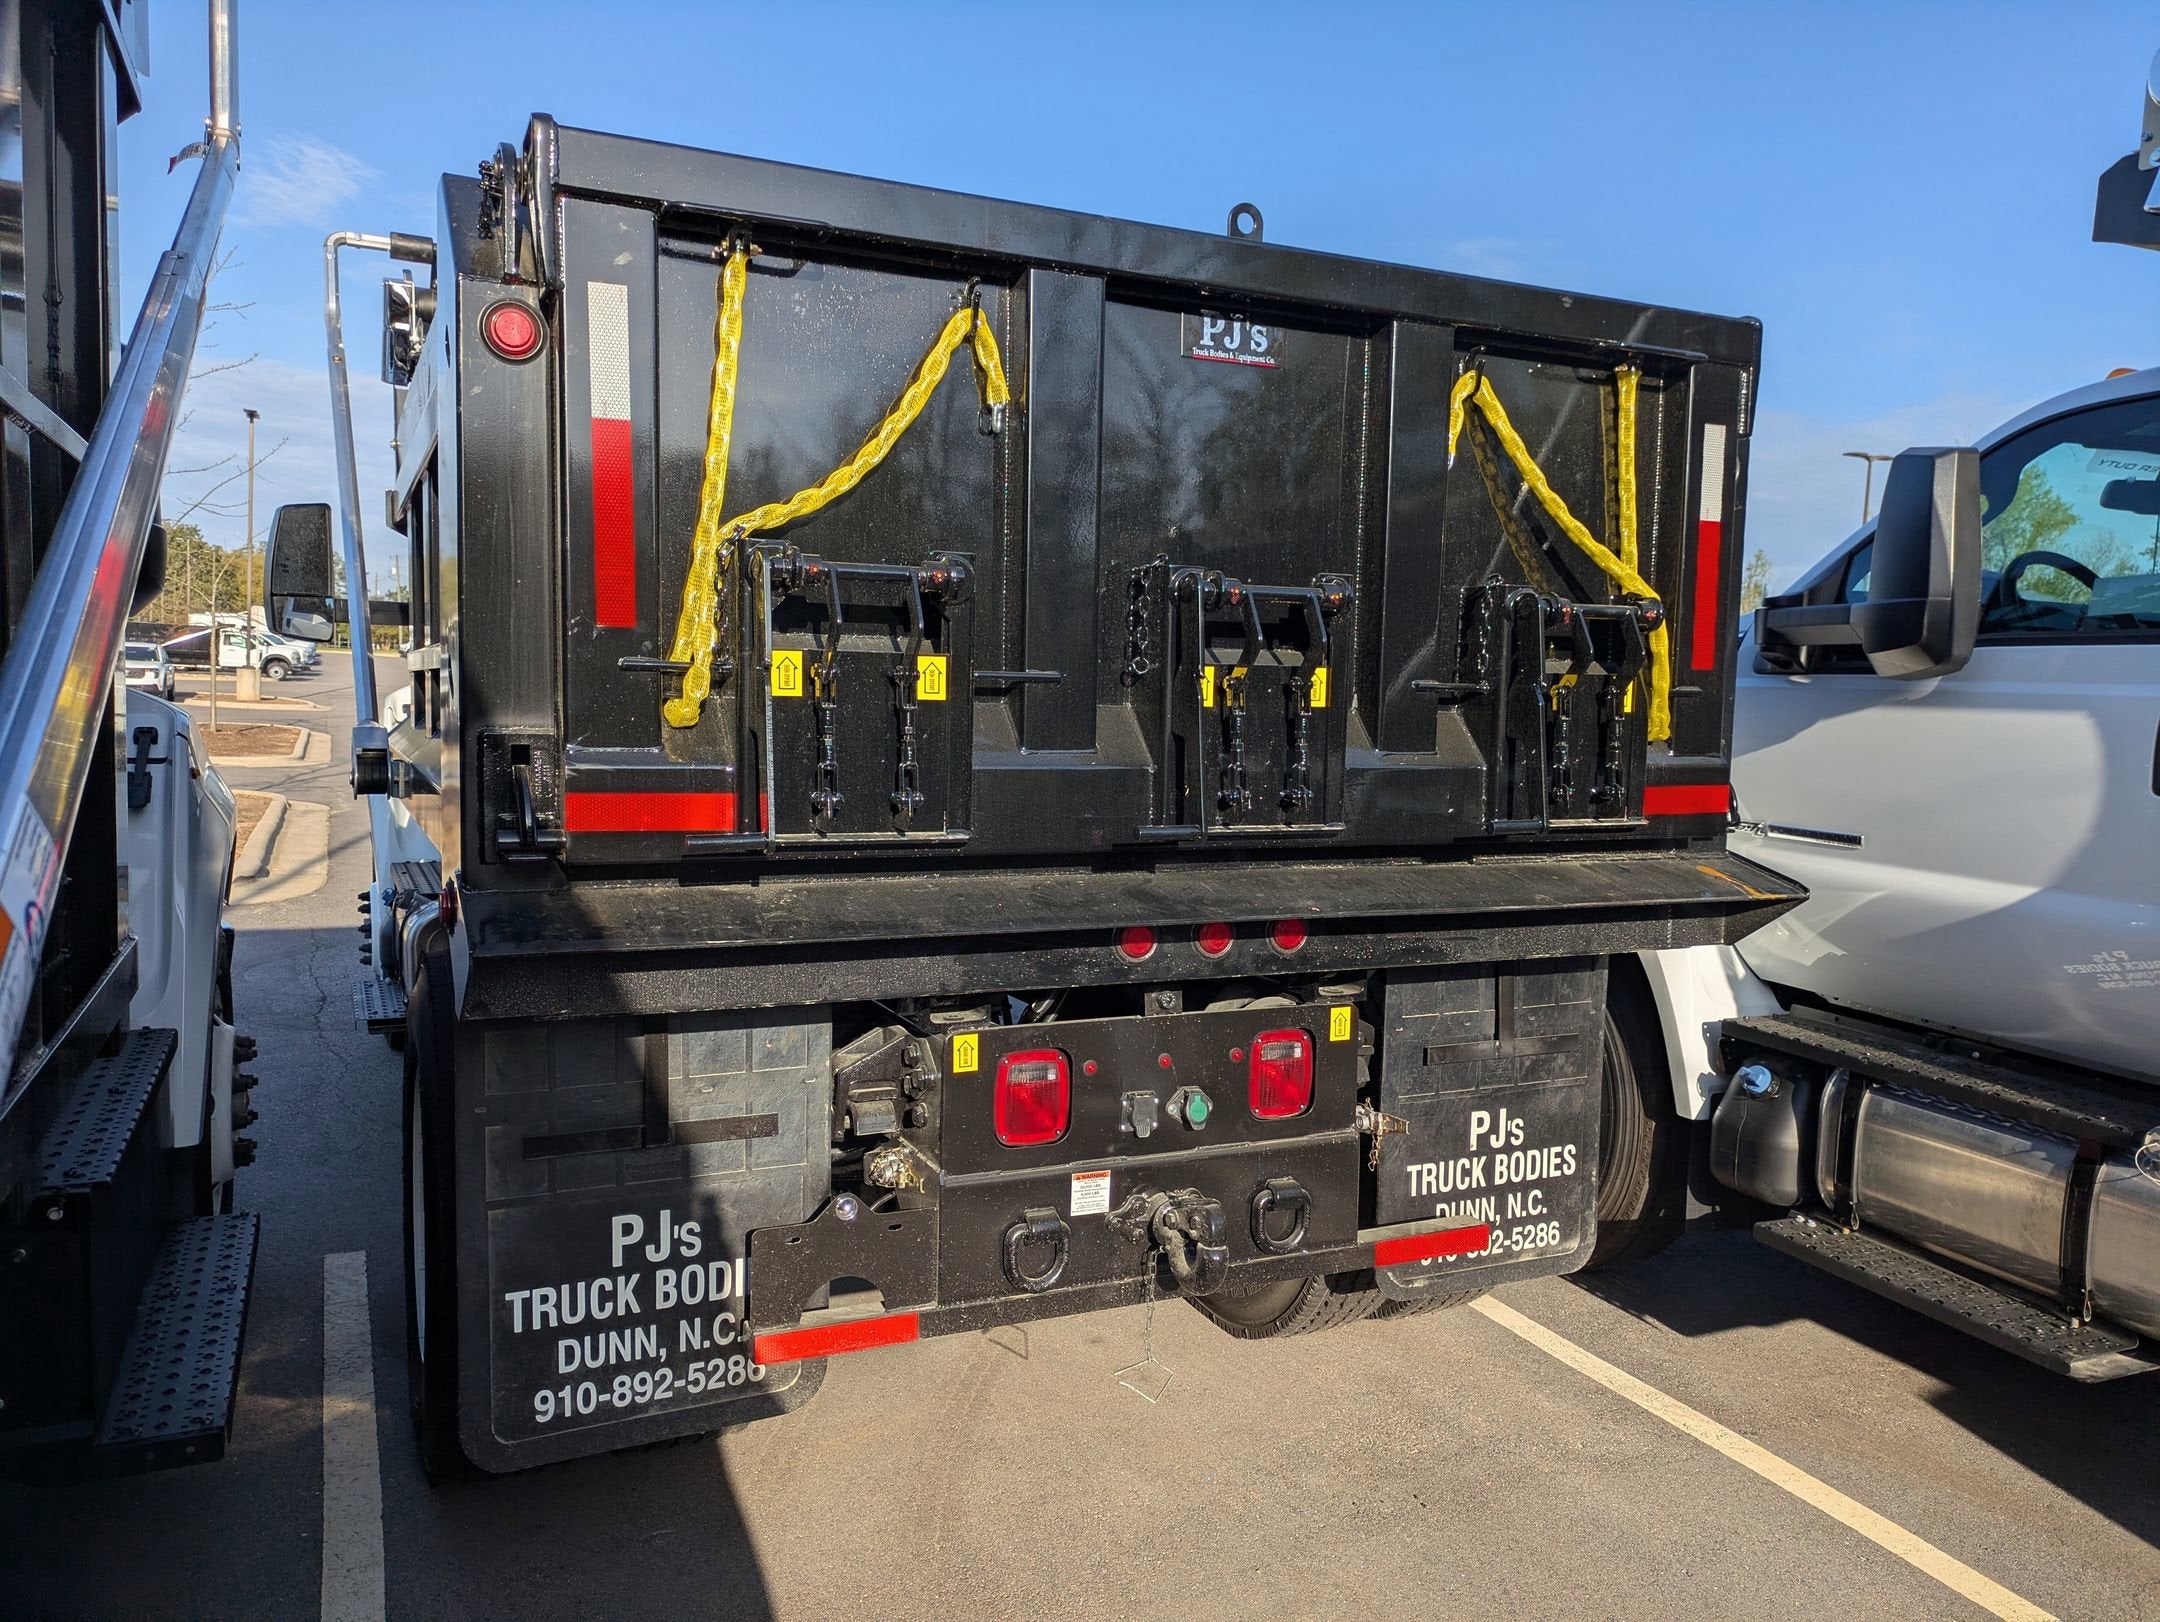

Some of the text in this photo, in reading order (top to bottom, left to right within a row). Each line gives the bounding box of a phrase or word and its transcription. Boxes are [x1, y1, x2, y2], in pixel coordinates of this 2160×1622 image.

[1192, 346, 1209, 356] Truck
[1210, 349, 1228, 359] Bodies
[1235, 353, 1265, 364] Equipment
[1266, 356, 1275, 364] Co.
[1200, 310, 1268, 353] PJ's
[1407, 1144, 1576, 1197] TRUCK BODIES
[1507, 1189, 1548, 1219] N.C.
[505, 1258, 744, 1334] TRUCK BODI
[558, 1324, 668, 1374] DUNN,
[533, 1353, 766, 1423] 910-892-5286
